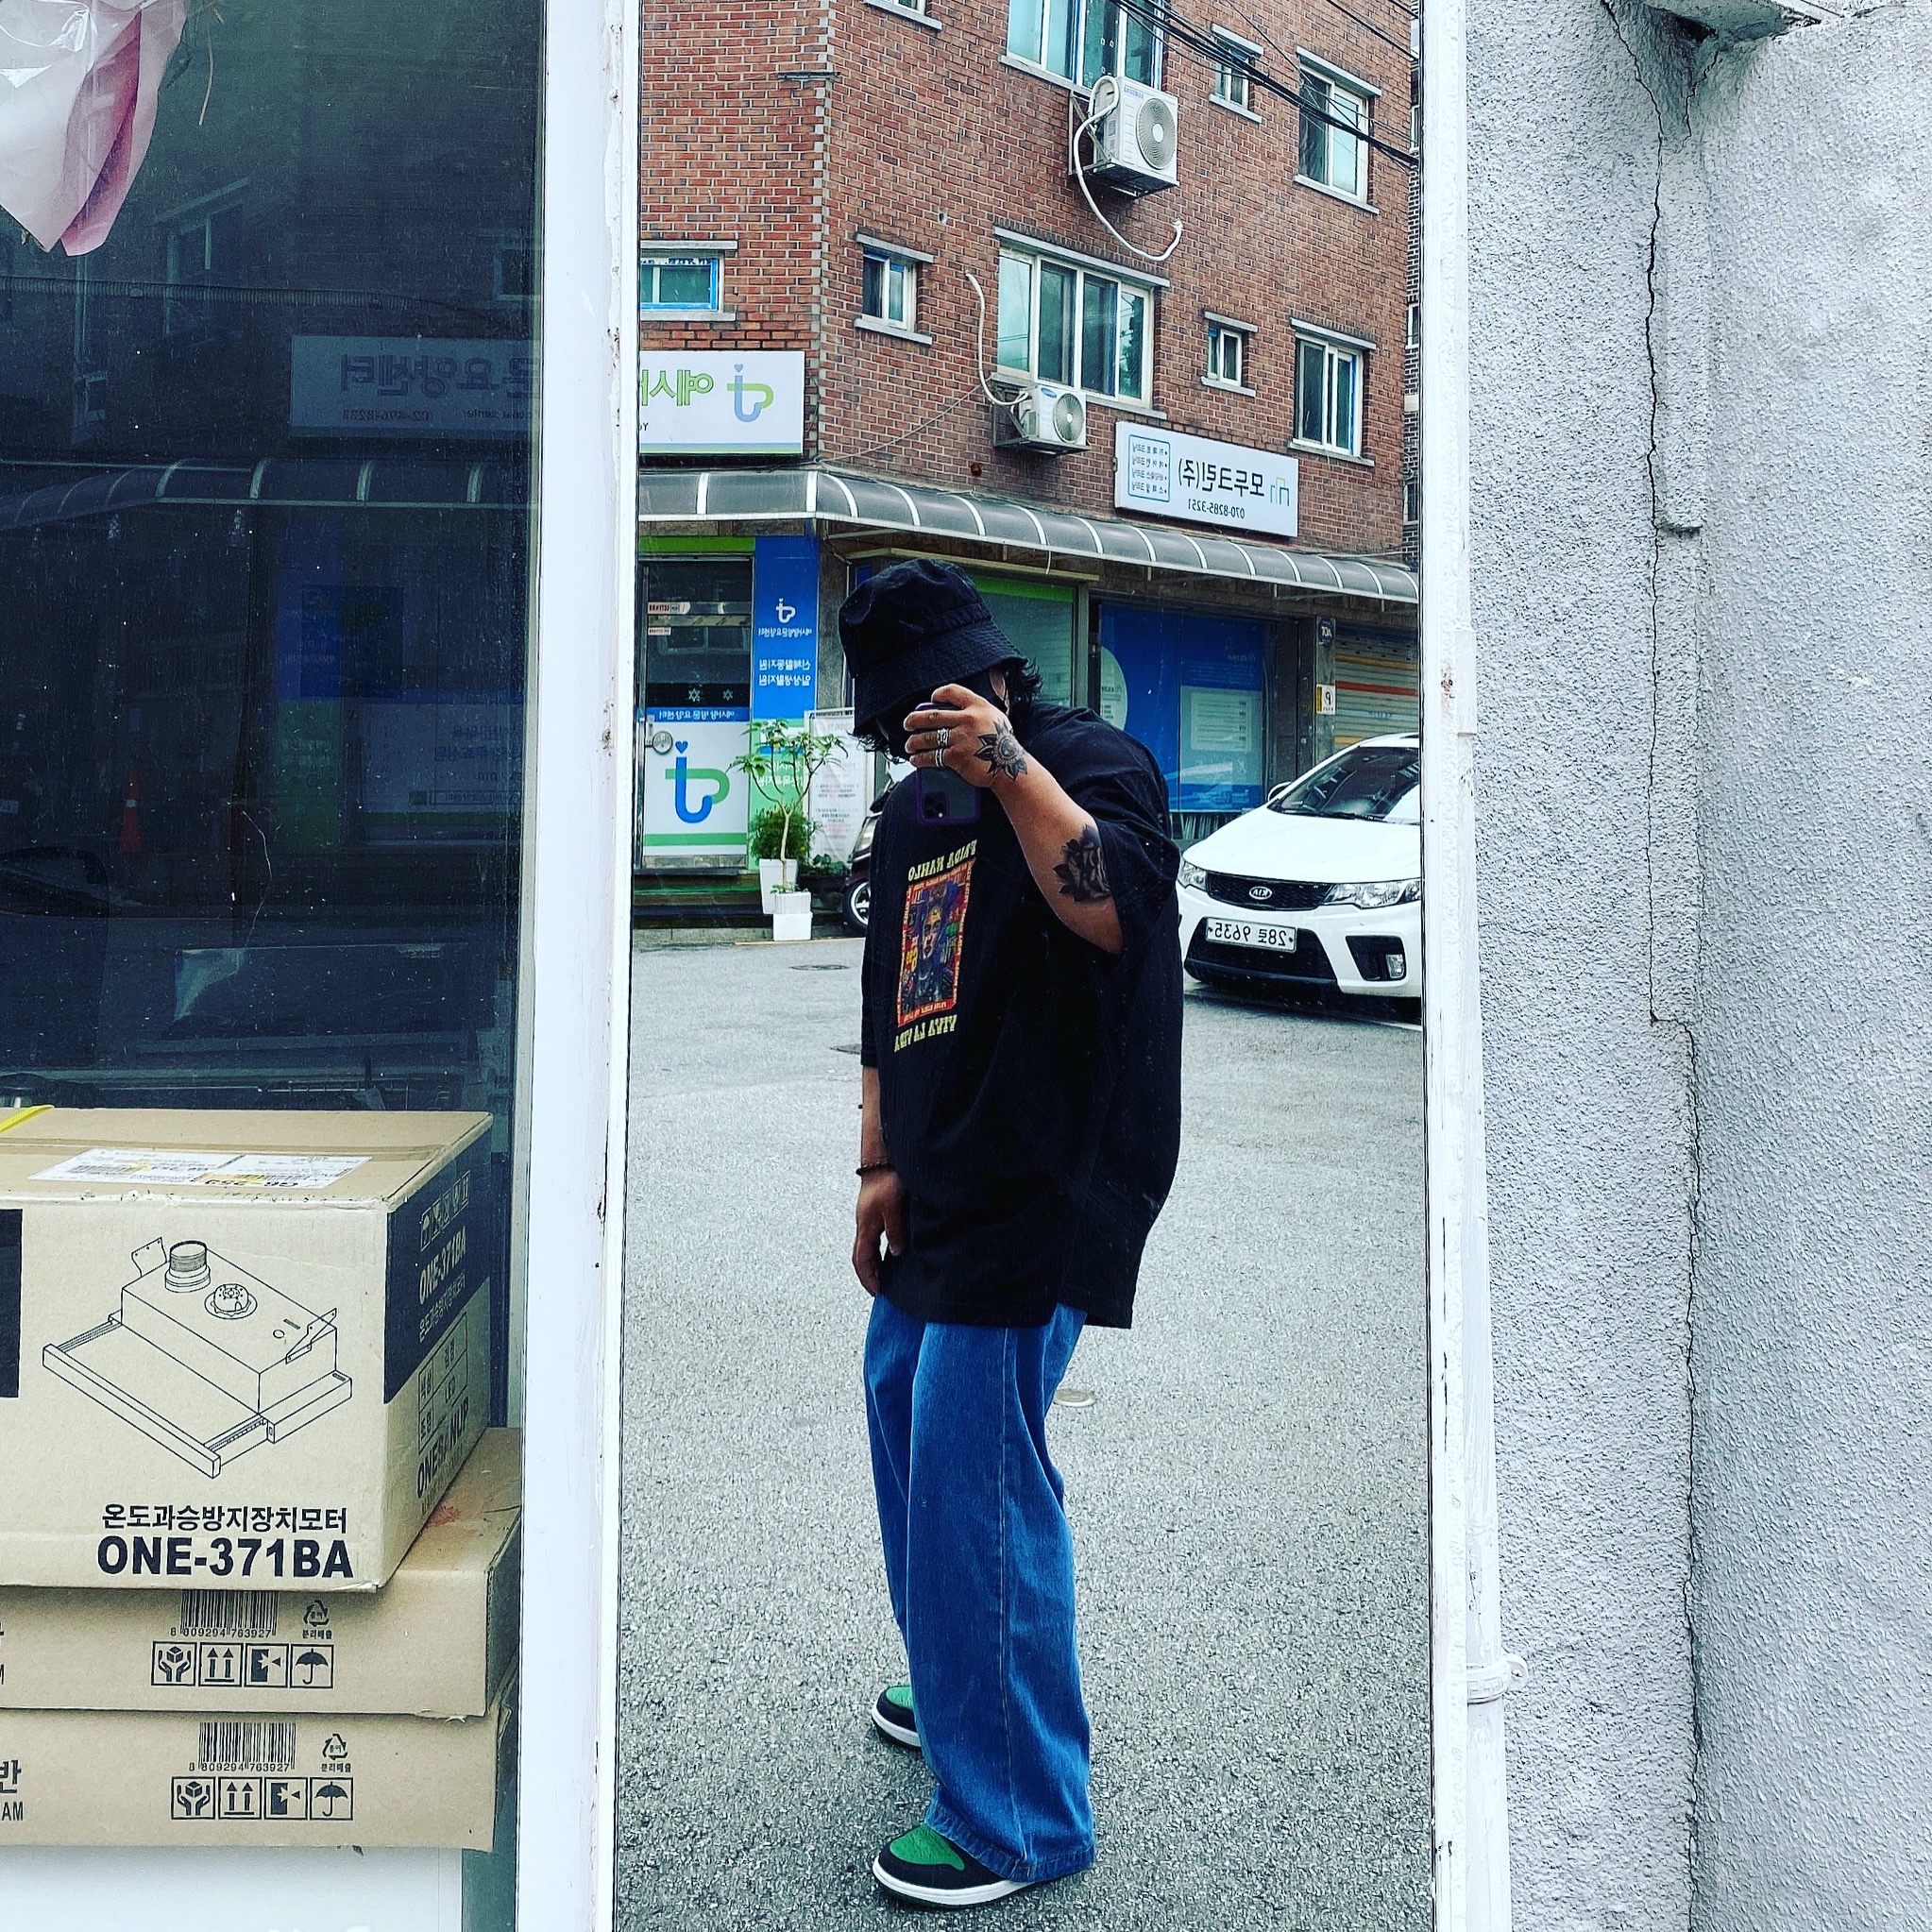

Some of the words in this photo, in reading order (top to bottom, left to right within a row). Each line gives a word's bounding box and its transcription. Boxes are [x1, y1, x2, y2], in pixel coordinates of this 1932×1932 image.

[419, 1225, 467, 1305] ONE-371BA
[445, 1375, 456, 1404] LED
[102, 1503, 347, 1534] 온도과승방지장치모터
[97, 1536, 354, 1579] ONE-371BA
[188, 1762, 195, 1772] 8
[201, 1762, 245, 1772] 809294
[249, 1762, 290, 1772] 763927
